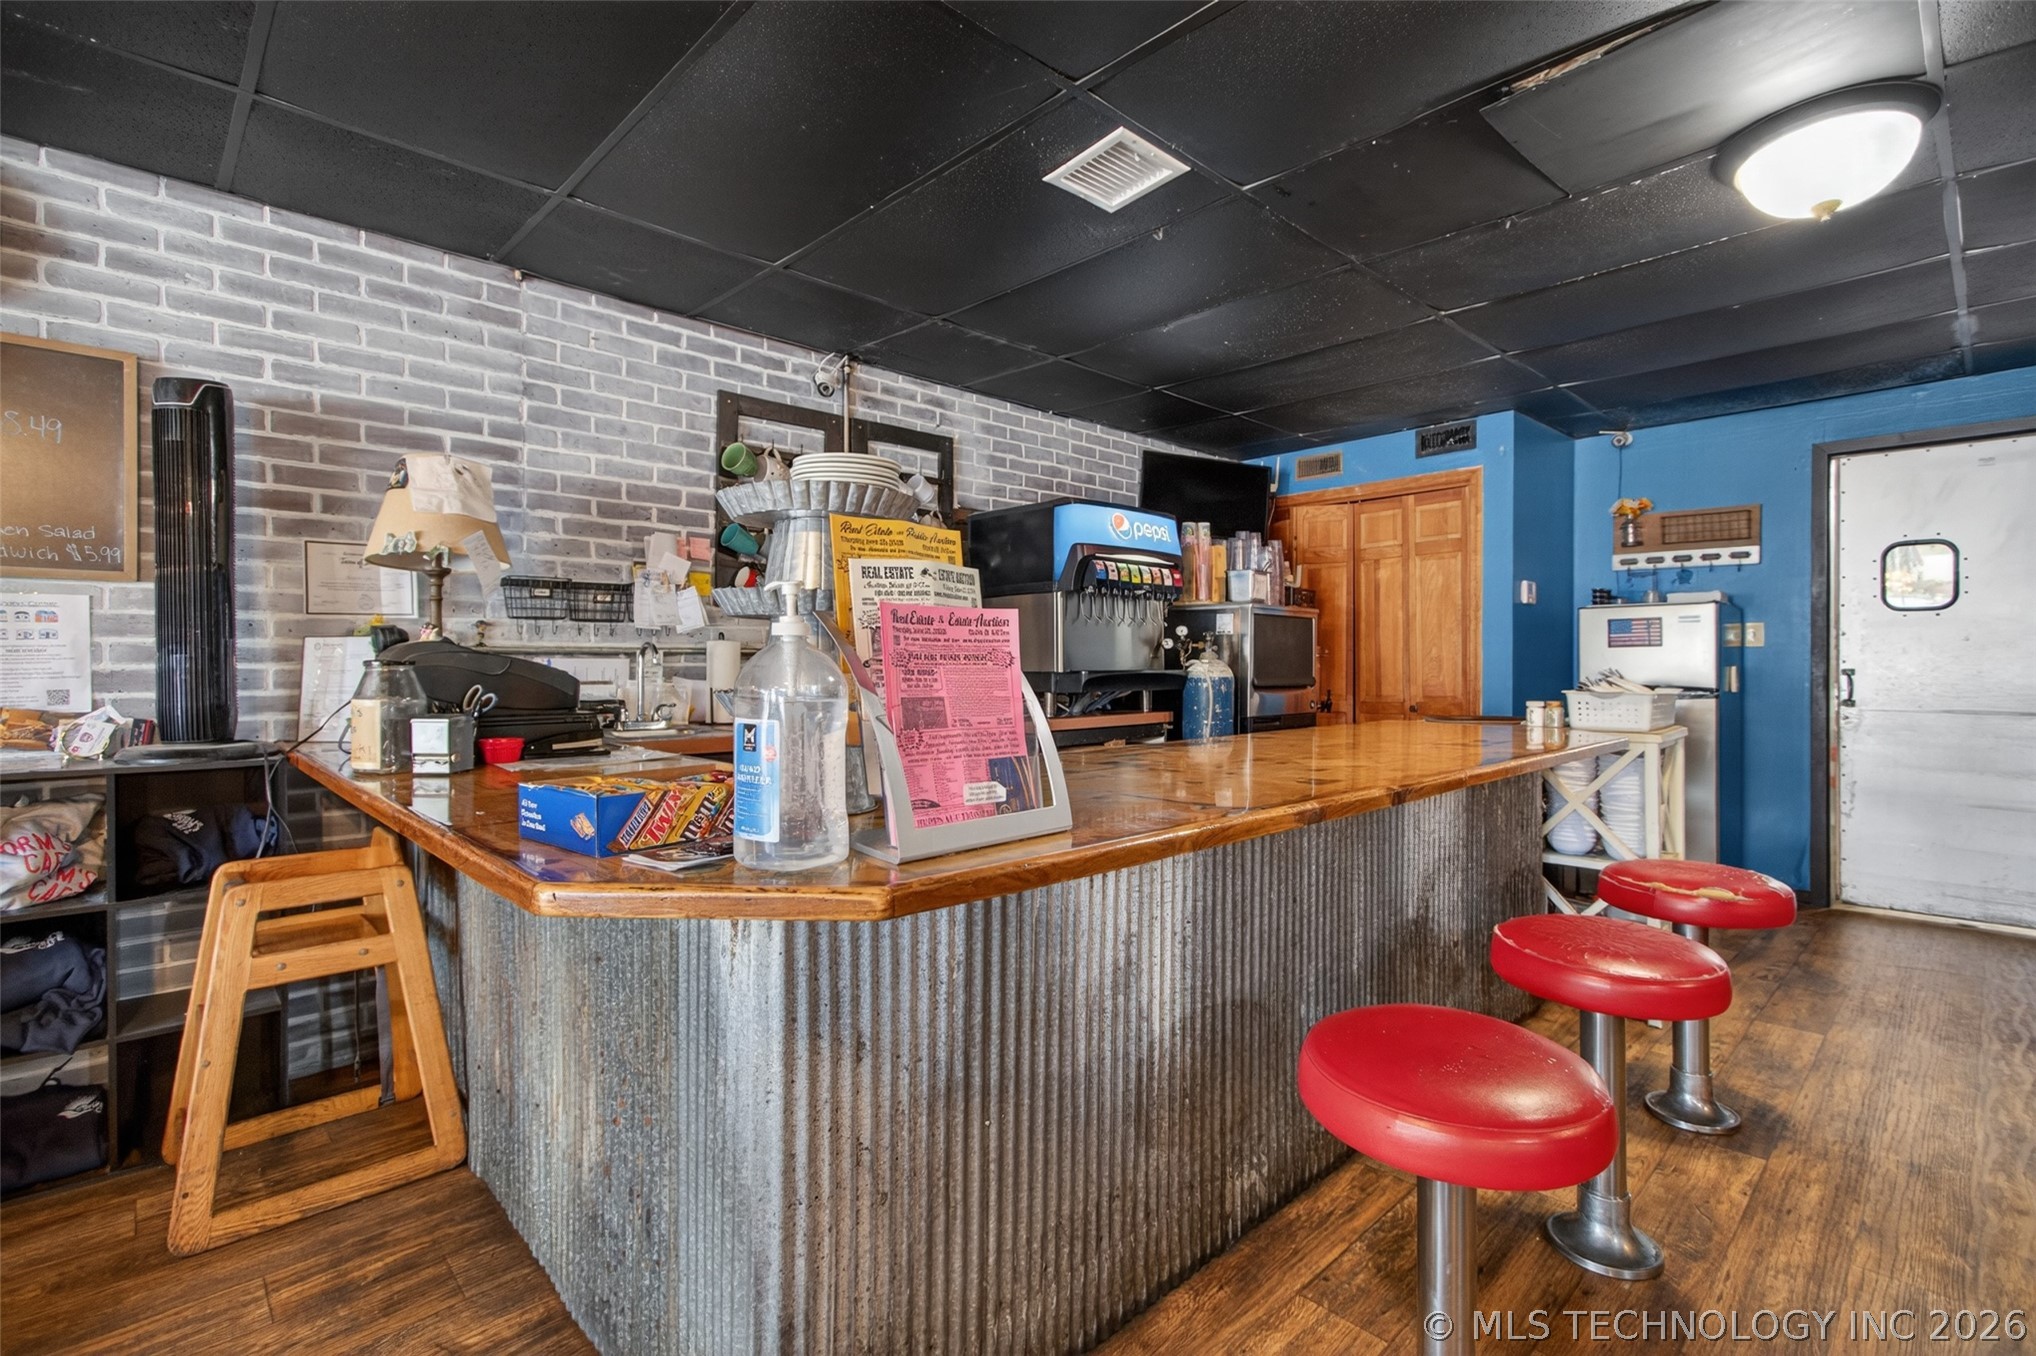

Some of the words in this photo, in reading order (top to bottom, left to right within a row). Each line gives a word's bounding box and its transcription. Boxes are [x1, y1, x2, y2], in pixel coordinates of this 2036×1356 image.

[38, 524, 96, 540] Salad
[839, 520, 864, 535] Real
[865, 522, 894, 537] Estate
[1133, 521, 1172, 542] pepsi
[65, 543, 122, 564] $5.99
[861, 565, 883, 580] REAL
[884, 566, 915, 580] ESTATE
[890, 608, 909, 625] Real
[909, 609, 936, 626] Estate
[938, 615, 945, 624] &
[948, 611, 973, 627] Estate
[973, 613, 1010, 628] Auction
[642, 788, 682, 844] TWIX
